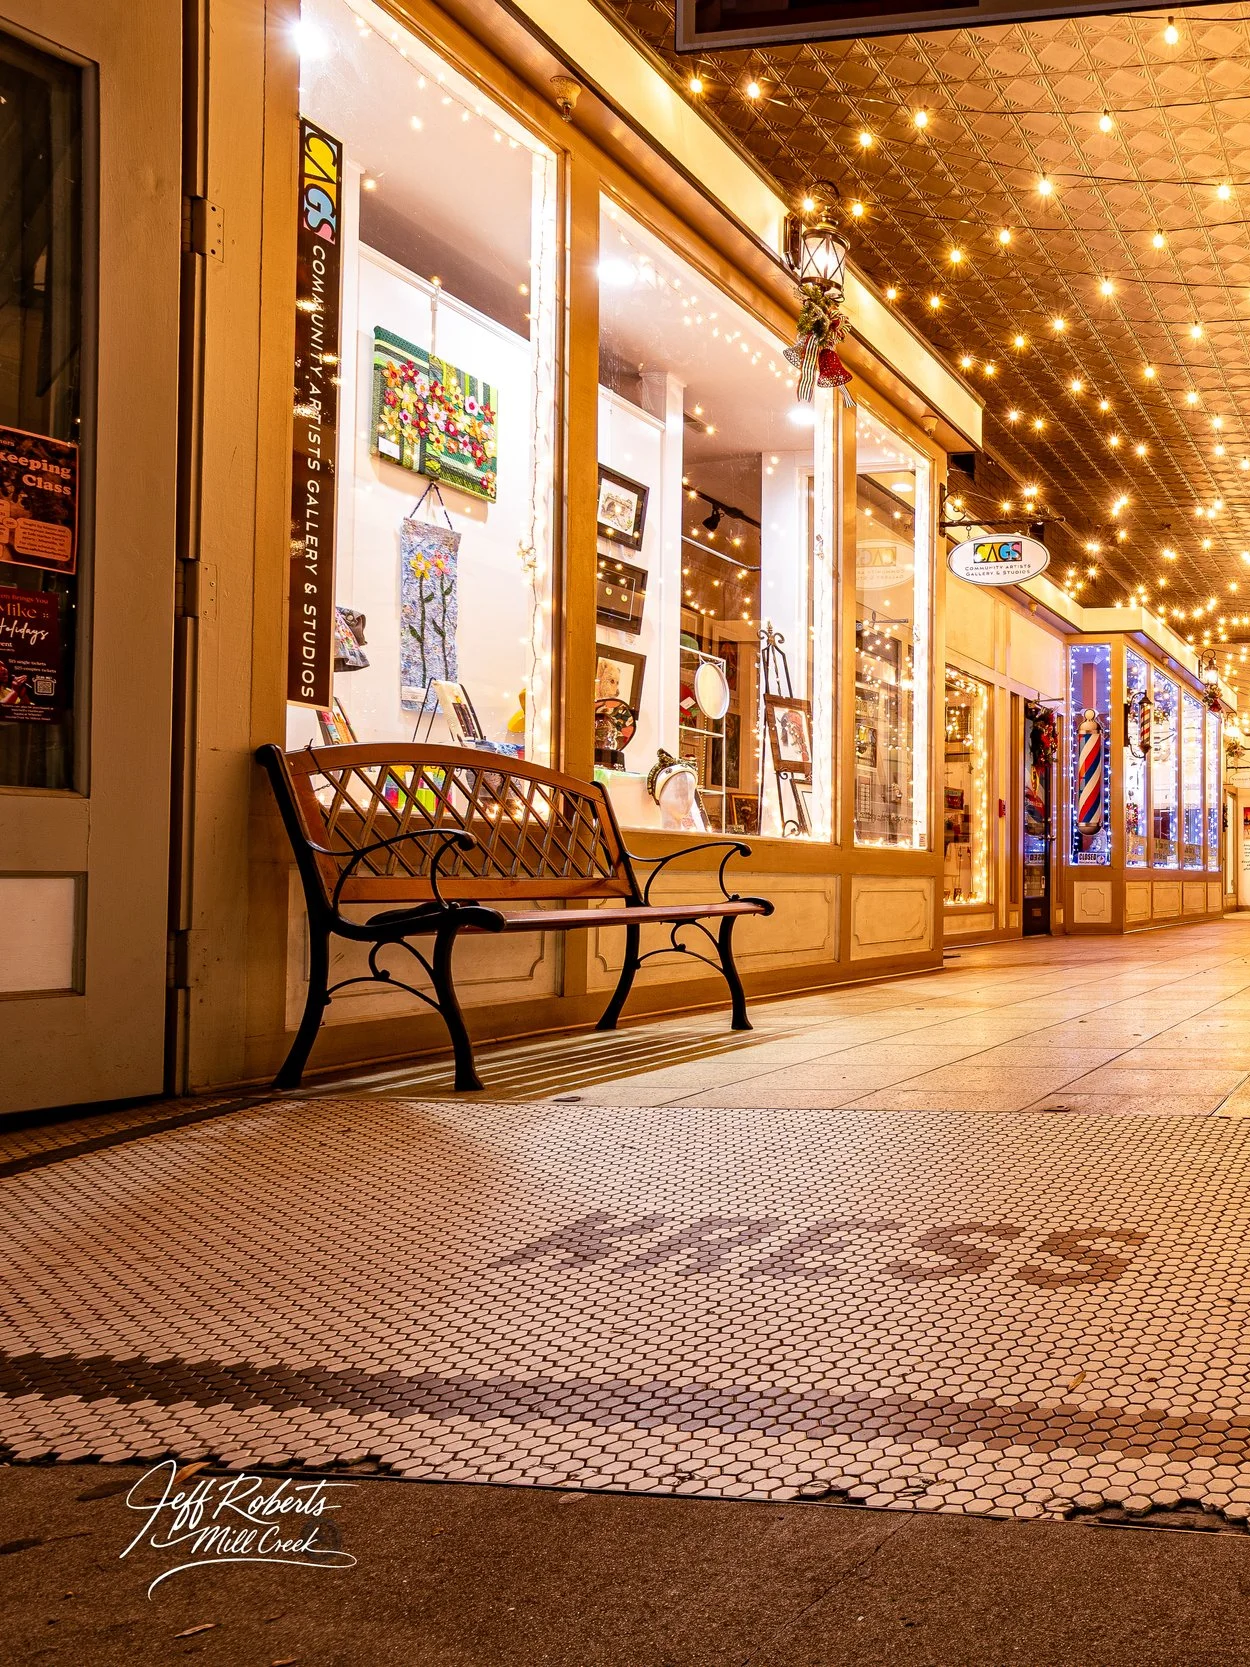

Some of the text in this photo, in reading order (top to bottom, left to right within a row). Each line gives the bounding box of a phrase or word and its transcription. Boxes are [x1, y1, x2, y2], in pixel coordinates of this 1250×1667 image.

[303, 126, 337, 245] CAGS
[22, 474, 71, 495] Class
[301, 244, 326, 699] COMMUNITY ARTISTS GALLERY & STUDIOS
[975, 541, 1022, 562] CAGS
[1079, 853, 1097, 861] CLOSED
[499, 1211, 1150, 1291] KRESS
